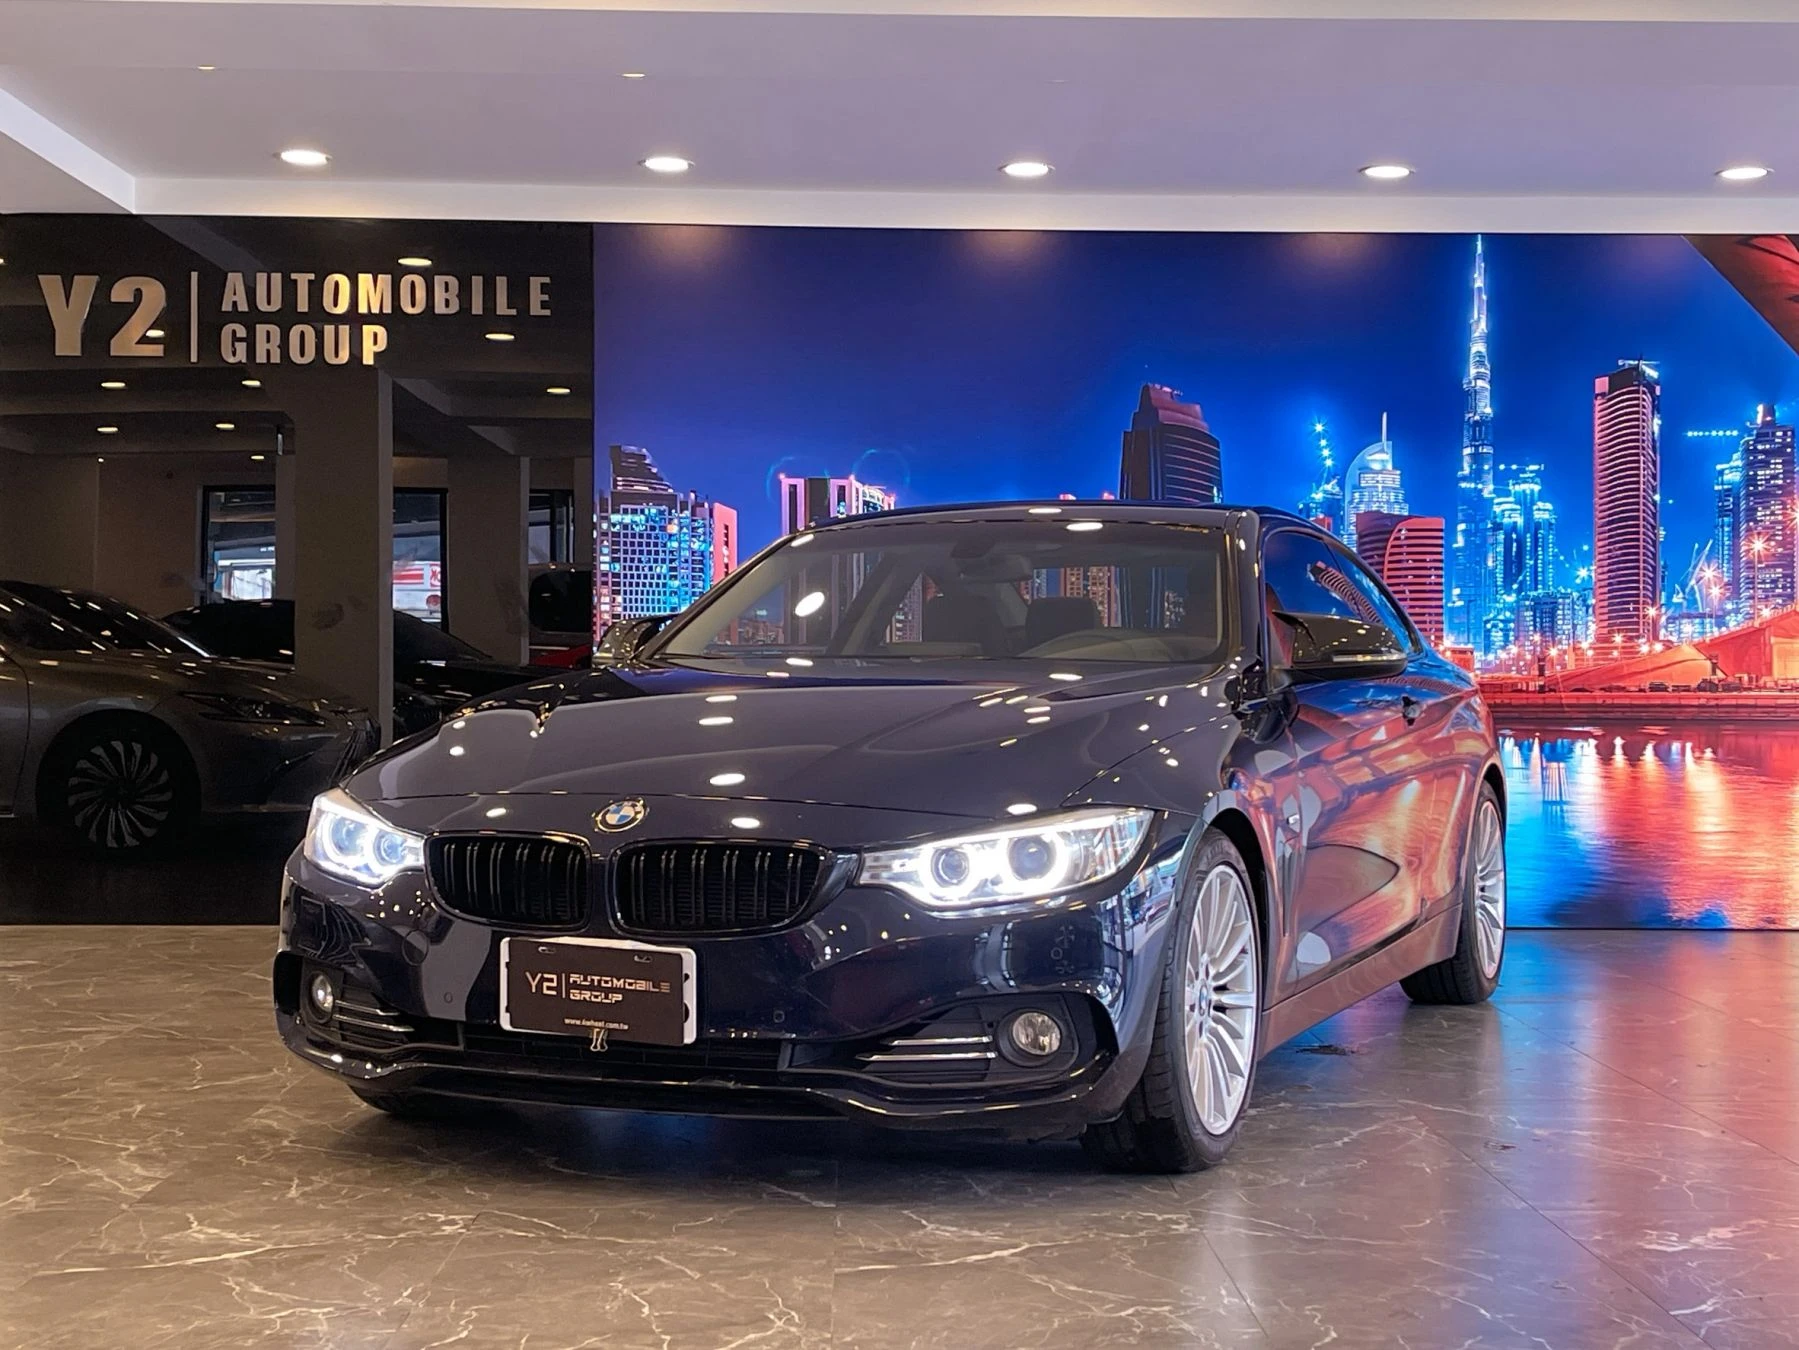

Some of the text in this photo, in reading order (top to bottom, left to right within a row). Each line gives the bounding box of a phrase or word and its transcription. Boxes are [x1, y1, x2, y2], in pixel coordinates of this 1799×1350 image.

[37, 272, 552, 357] Y2 AUTOMOBILE
[220, 323, 389, 366] GROUP
[525, 971, 671, 996] Y2 AUTOMOBILE
[569, 989, 624, 1004] GROUP
